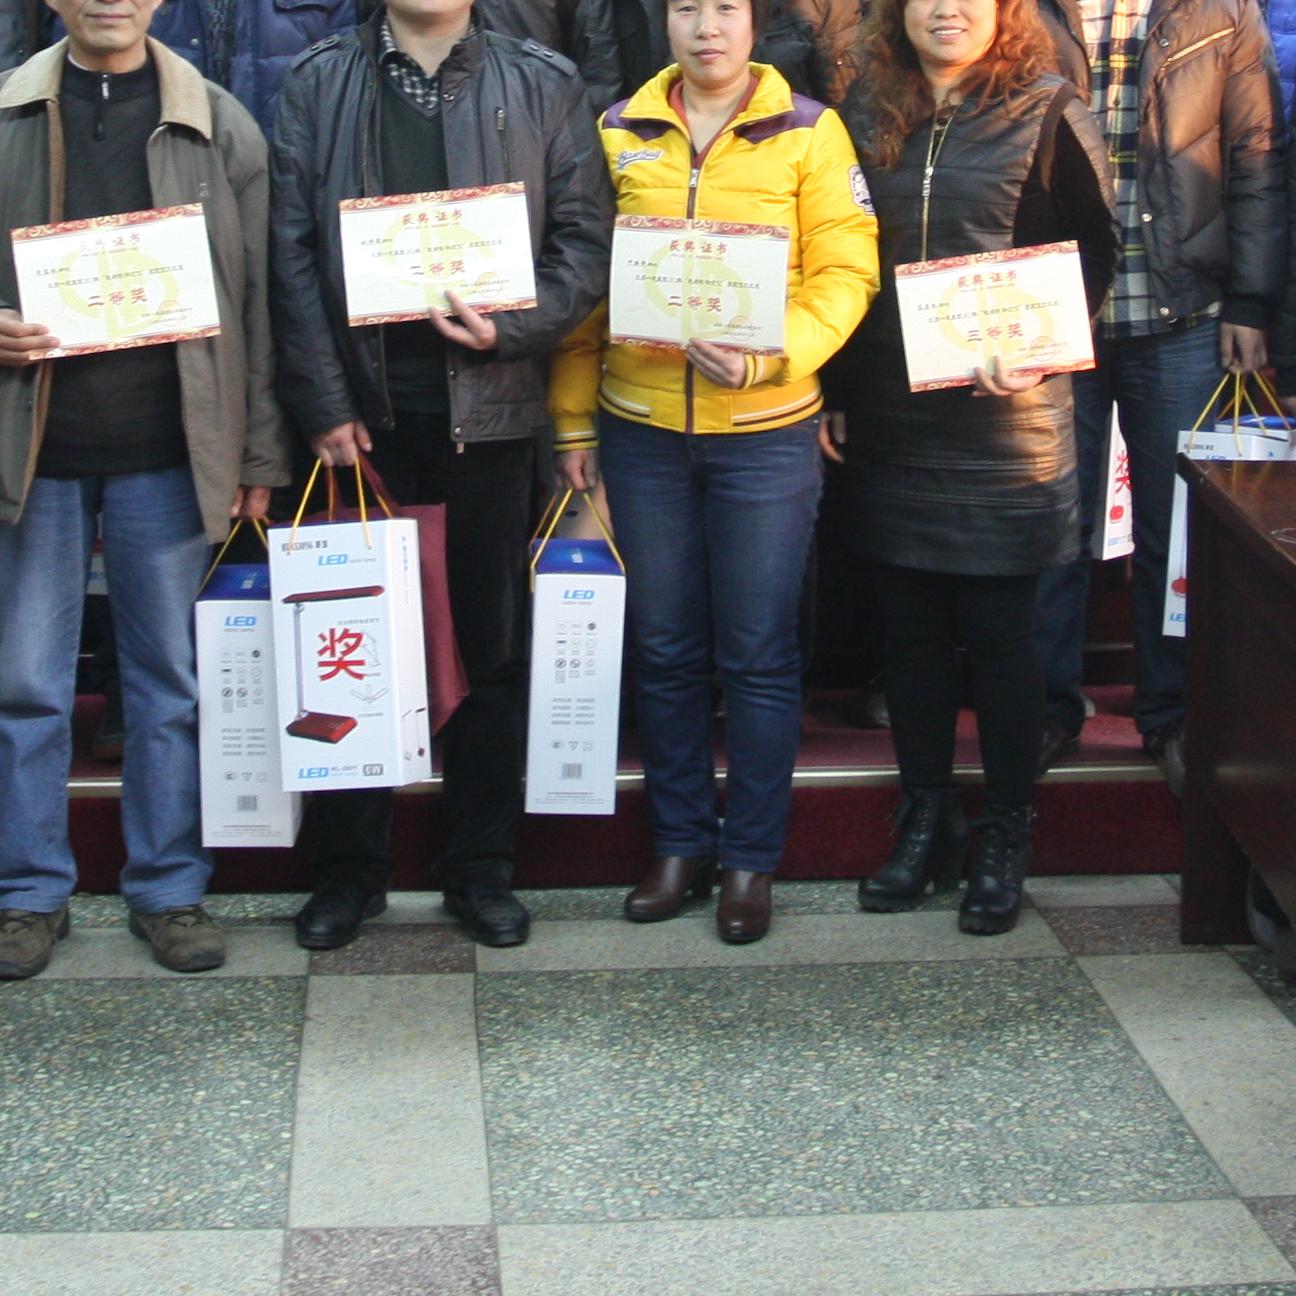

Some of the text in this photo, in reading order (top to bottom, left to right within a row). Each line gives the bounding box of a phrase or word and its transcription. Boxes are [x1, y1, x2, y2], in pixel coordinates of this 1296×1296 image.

[402, 208, 463, 226] 获奖证书
[669, 240, 728, 254] 获奖证书
[410, 259, 466, 276] 二等奖
[957, 269, 1018, 288] 获奖证书
[87, 287, 148, 308] 二等奖
[667, 295, 723, 313] 二等奖
[967, 322, 1024, 343] 三等奖
[318, 554, 348, 566] LED
[563, 589, 595, 600] LED
[224, 616, 257, 627] LED
[317, 627, 366, 683] 奖
[299, 767, 329, 779] LED
